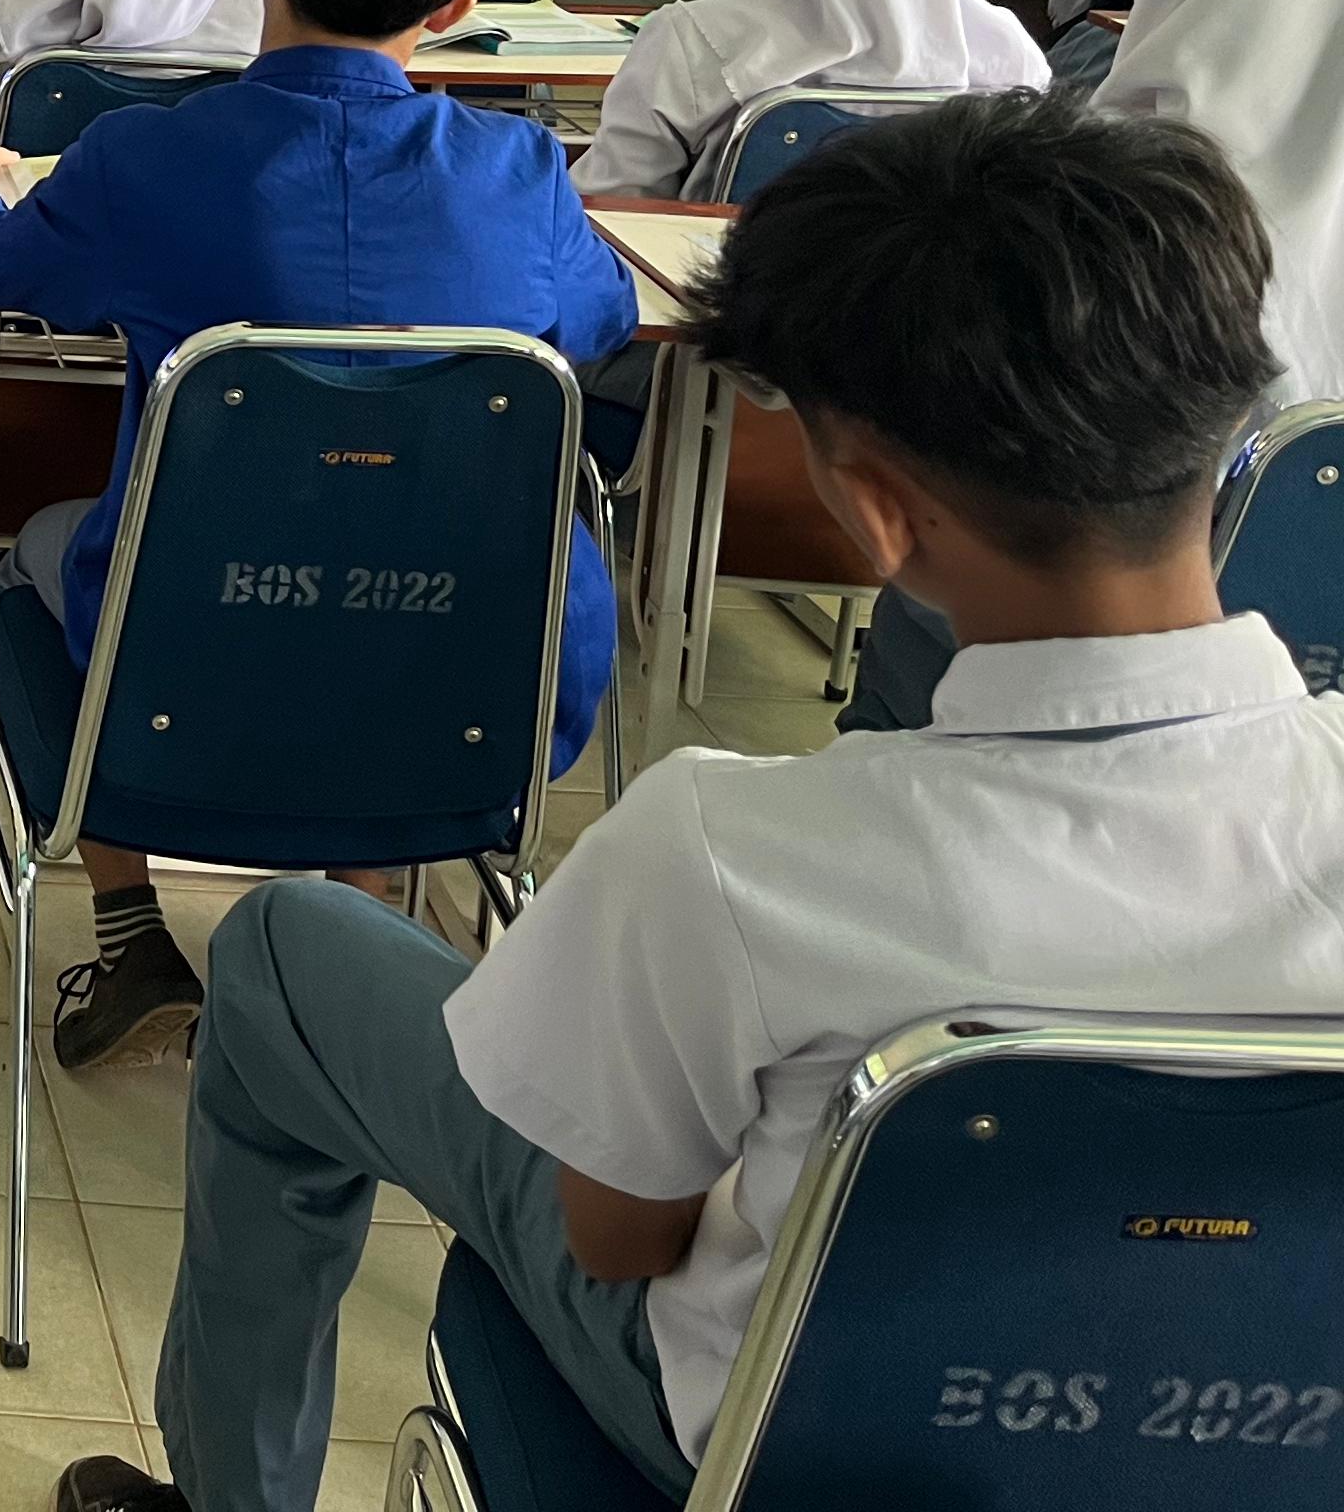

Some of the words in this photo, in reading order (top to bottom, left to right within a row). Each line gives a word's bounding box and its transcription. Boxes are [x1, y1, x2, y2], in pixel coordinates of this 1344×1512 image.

[220, 561, 323, 607] BOS
[341, 567, 457, 614] 2022
[1163, 1218, 1250, 1236] FUTURA
[930, 1366, 1108, 1433] BOS
[1137, 1376, 1344, 1445] 2022
